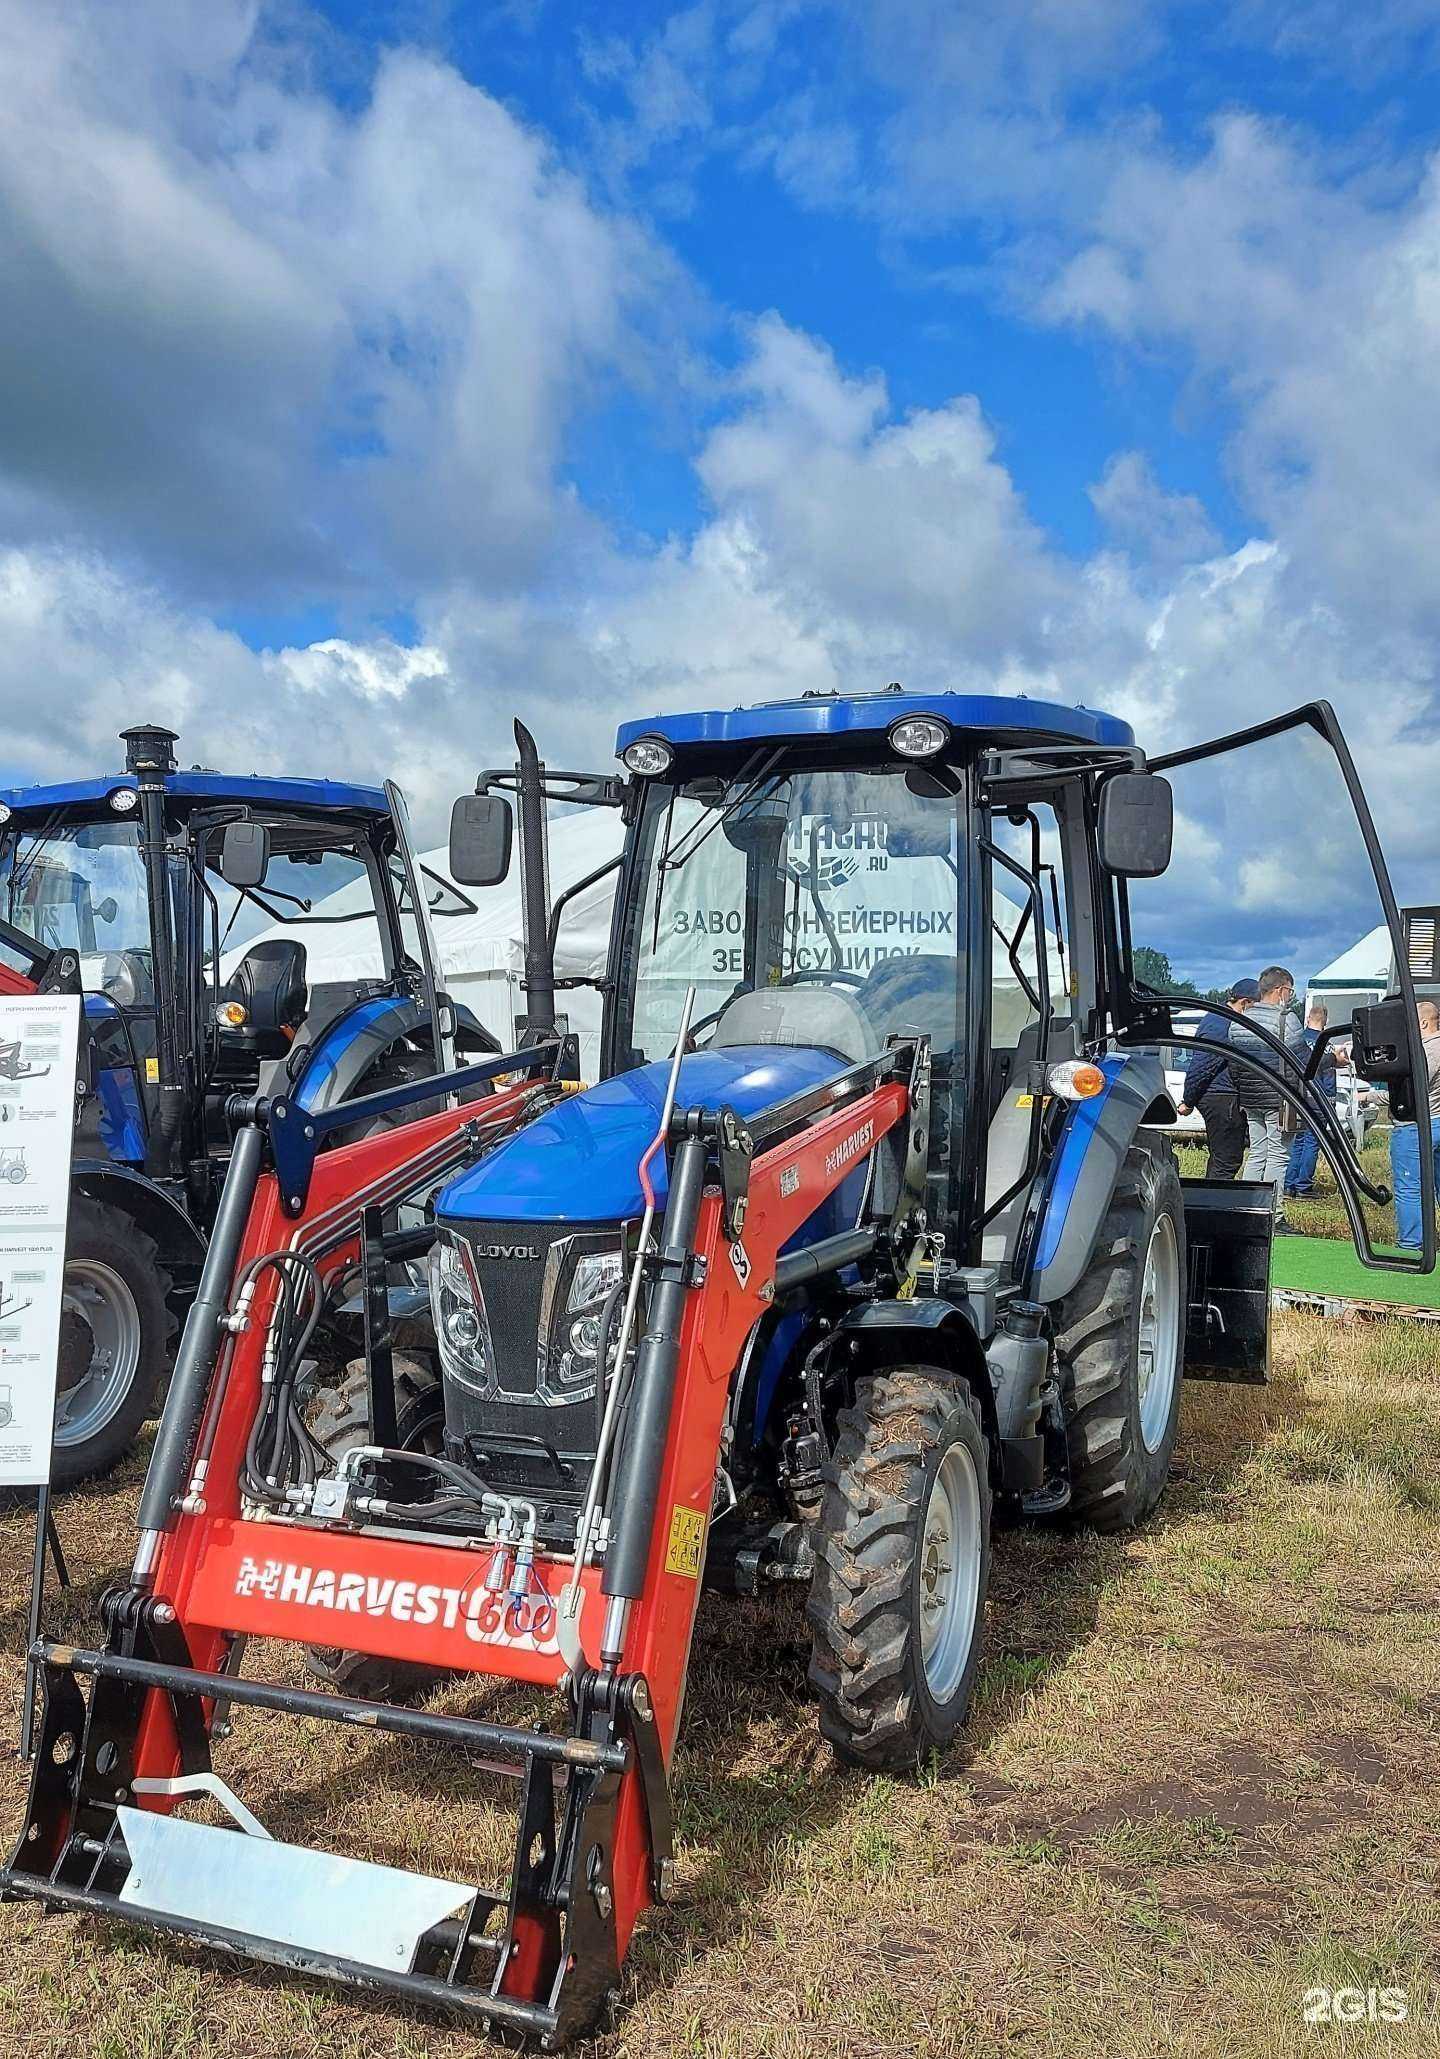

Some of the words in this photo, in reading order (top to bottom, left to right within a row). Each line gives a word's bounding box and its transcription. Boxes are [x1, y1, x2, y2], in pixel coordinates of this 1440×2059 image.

[866, 856, 888, 871] .RU
[673, 910, 745, 935] ЗАВО
[784, 905, 953, 934] ОНВЕЙЕРНЫХ
[835, 1118, 875, 1168] HARVEST
[477, 1244, 541, 1259] LOVOL
[281, 1562, 467, 1629] HARVEST
[472, 1590, 560, 1651] 600
